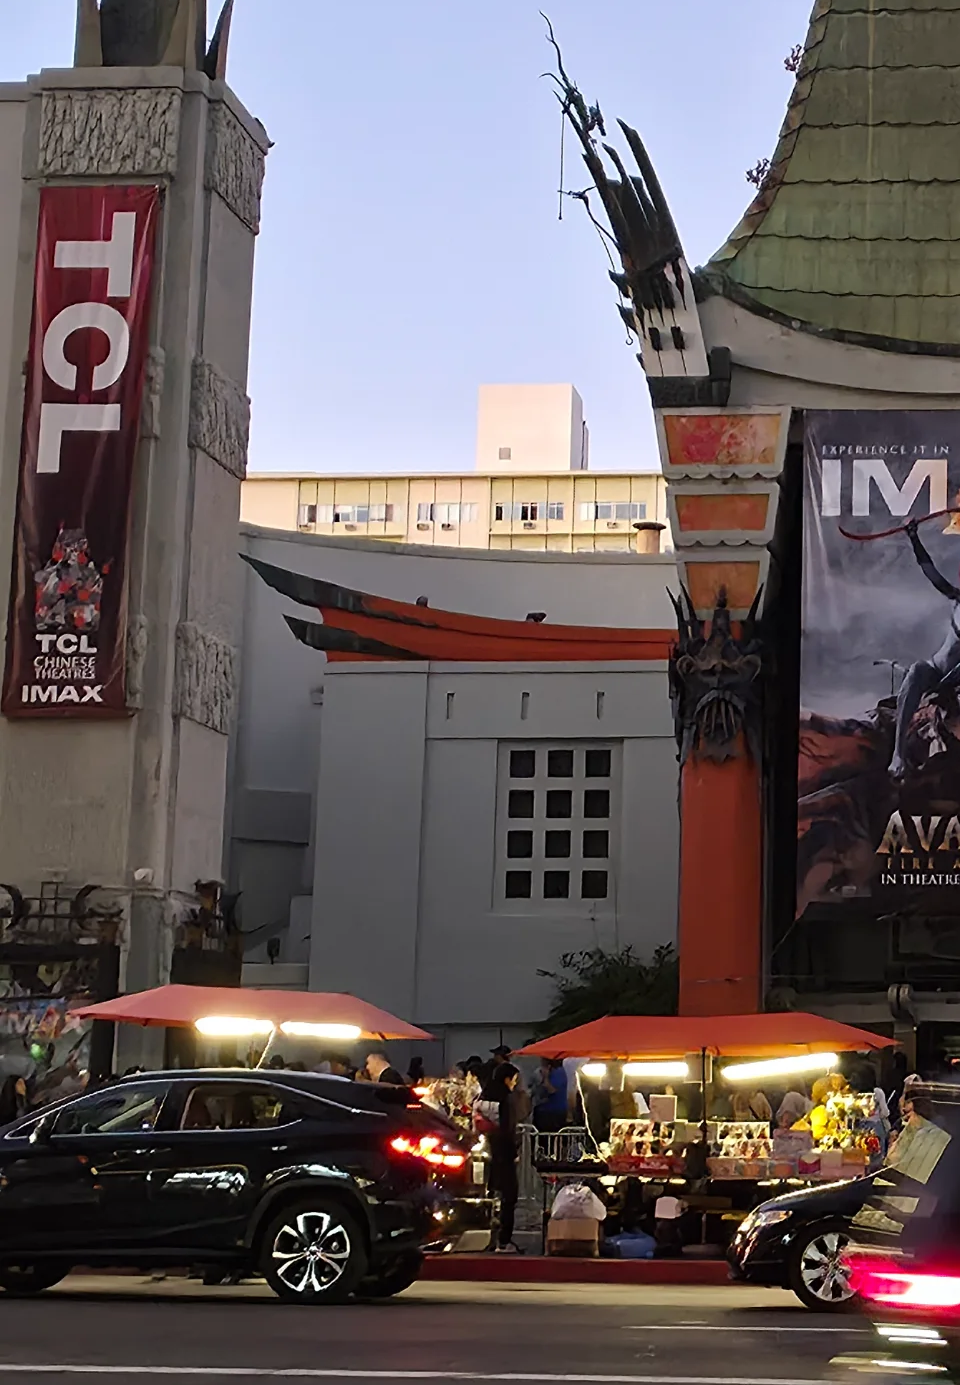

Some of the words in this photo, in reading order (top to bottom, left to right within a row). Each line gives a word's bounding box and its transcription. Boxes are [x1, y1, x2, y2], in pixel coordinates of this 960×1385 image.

[36, 211, 136, 473] TCL
[822, 445, 906, 455] EXPERIENCE
[914, 445, 926, 454] IT
[934, 445, 949, 454] IN
[35, 633, 97, 653] TCL
[33, 656, 96, 668] CHINESE
[34, 666, 95, 679] THEATRES
[21, 684, 104, 703] IMAX
[887, 857, 934, 869] FIRE
[881, 874, 897, 885] IN
